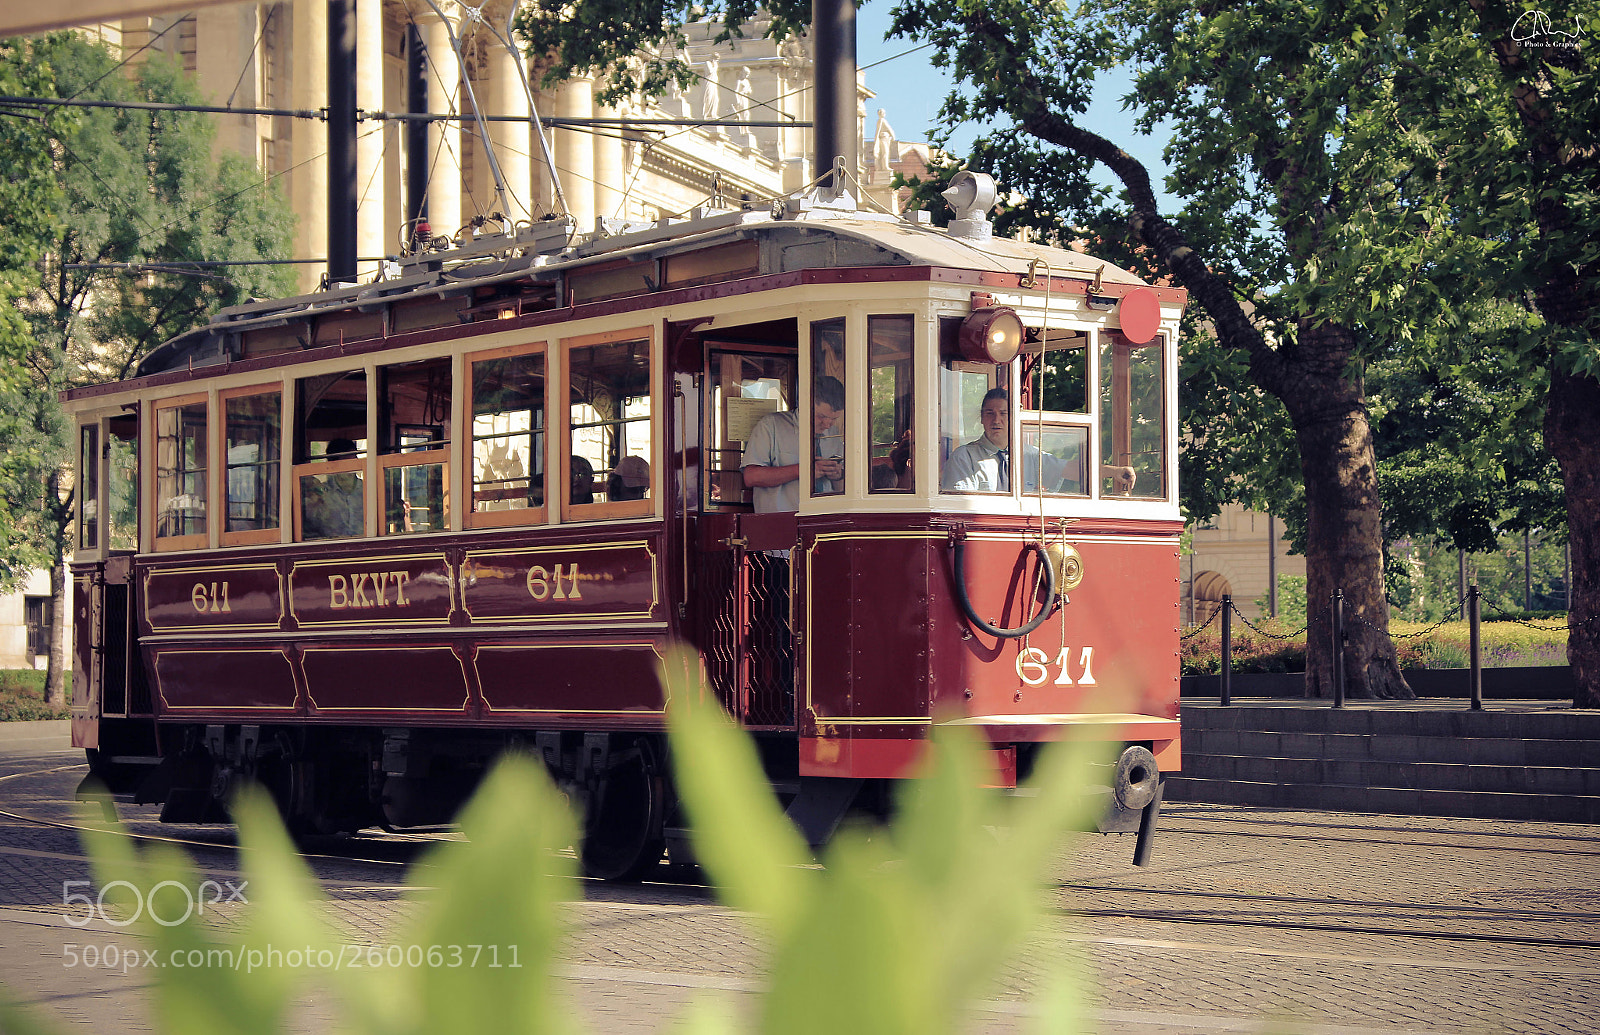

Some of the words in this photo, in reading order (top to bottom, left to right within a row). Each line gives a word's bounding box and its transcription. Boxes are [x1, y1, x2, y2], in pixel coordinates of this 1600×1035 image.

[191, 581, 231, 614] 611
[328, 571, 410, 610] B.K.V.T.
[527, 563, 582, 601] 611
[1015, 646, 1098, 688] 611
